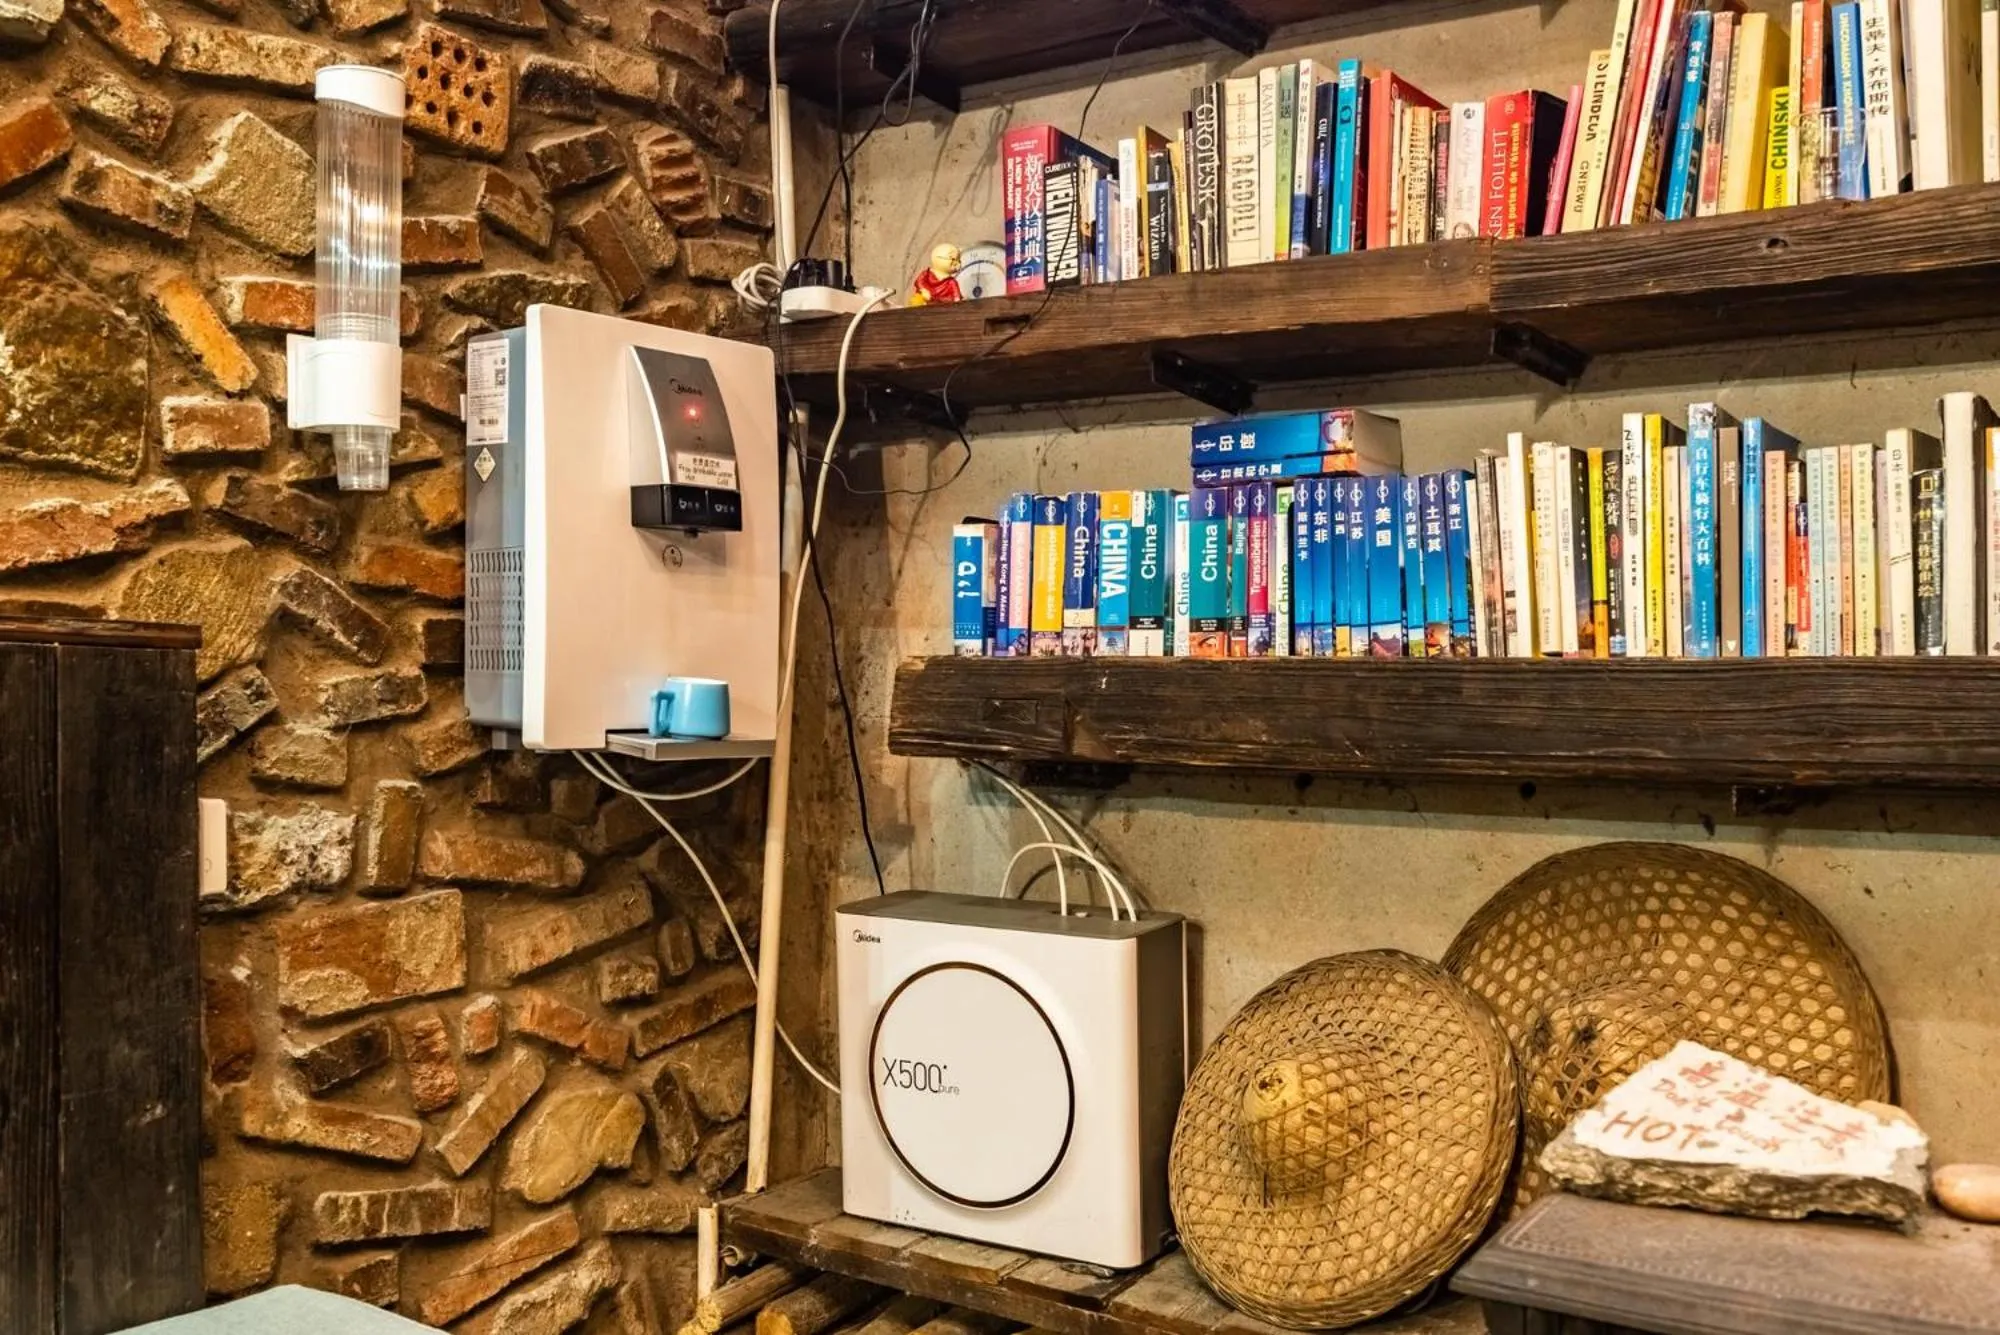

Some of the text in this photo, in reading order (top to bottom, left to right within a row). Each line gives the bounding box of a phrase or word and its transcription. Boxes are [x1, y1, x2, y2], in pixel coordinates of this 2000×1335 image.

[1865, 15, 1891, 118] 史蒂夫·乔布斯传
[1196, 103, 1218, 205] GROTESK
[1489, 128, 1508, 200] FOLLETT
[1231, 153, 1257, 238] RAGDOLL
[1510, 171, 1518, 184] de
[1023, 153, 1044, 265] 新英汉词典
[1508, 187, 1518, 219] portes
[1046, 172, 1079, 283] WELTWUNDER
[1150, 214, 1161, 260] WIZARD
[1314, 510, 1329, 544] 东非
[1334, 511, 1346, 535] 山西
[1351, 511, 1364, 540] 江苏
[1375, 507, 1392, 547] 美国
[1449, 503, 1462, 530] 浙江
[1694, 446, 1713, 566] 自行车骑行大百科
[1000, 539, 1009, 561] Hong
[1074, 525, 1089, 578] China
[1141, 524, 1158, 579] China
[1235, 522, 1244, 555] Beijing
[1405, 511, 1417, 549] 内蒙古
[1426, 505, 1442, 553] 土耳其
[999, 563, 1009, 584] Kong
[1102, 522, 1128, 598] CHINA
[1202, 525, 1219, 582] China
[1250, 521, 1261, 595] Transsibérien
[1177, 571, 1188, 616] Chine
[853, 929, 881, 944] Midea
[882, 1057, 943, 1094] X500
[1602, 1109, 1709, 1152] HOT
